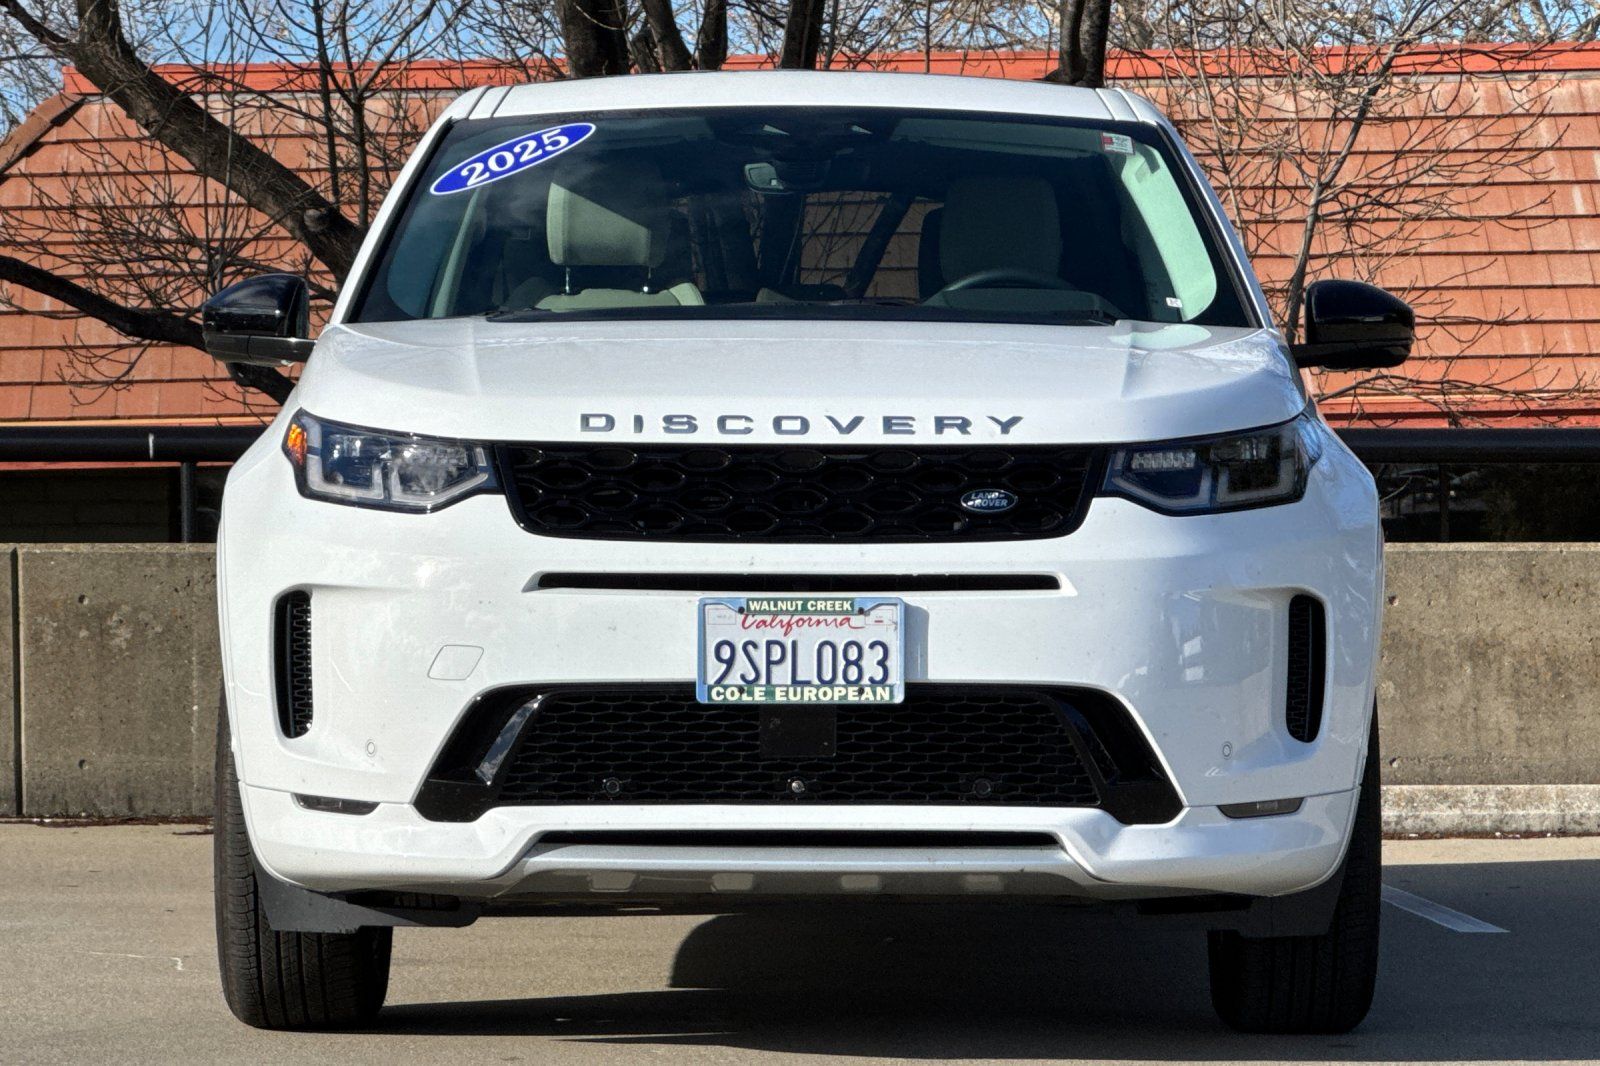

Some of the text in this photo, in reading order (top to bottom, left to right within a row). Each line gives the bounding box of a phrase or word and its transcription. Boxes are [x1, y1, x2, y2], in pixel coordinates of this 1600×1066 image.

[460, 128, 570, 186] 2025
[579, 412, 1024, 436] DISCOVERY
[749, 600, 853, 611] WALNUT CREEK
[741, 613, 865, 636] California
[713, 639, 889, 685] 9SPL083
[710, 686, 891, 701] COLE EUROPEAN
